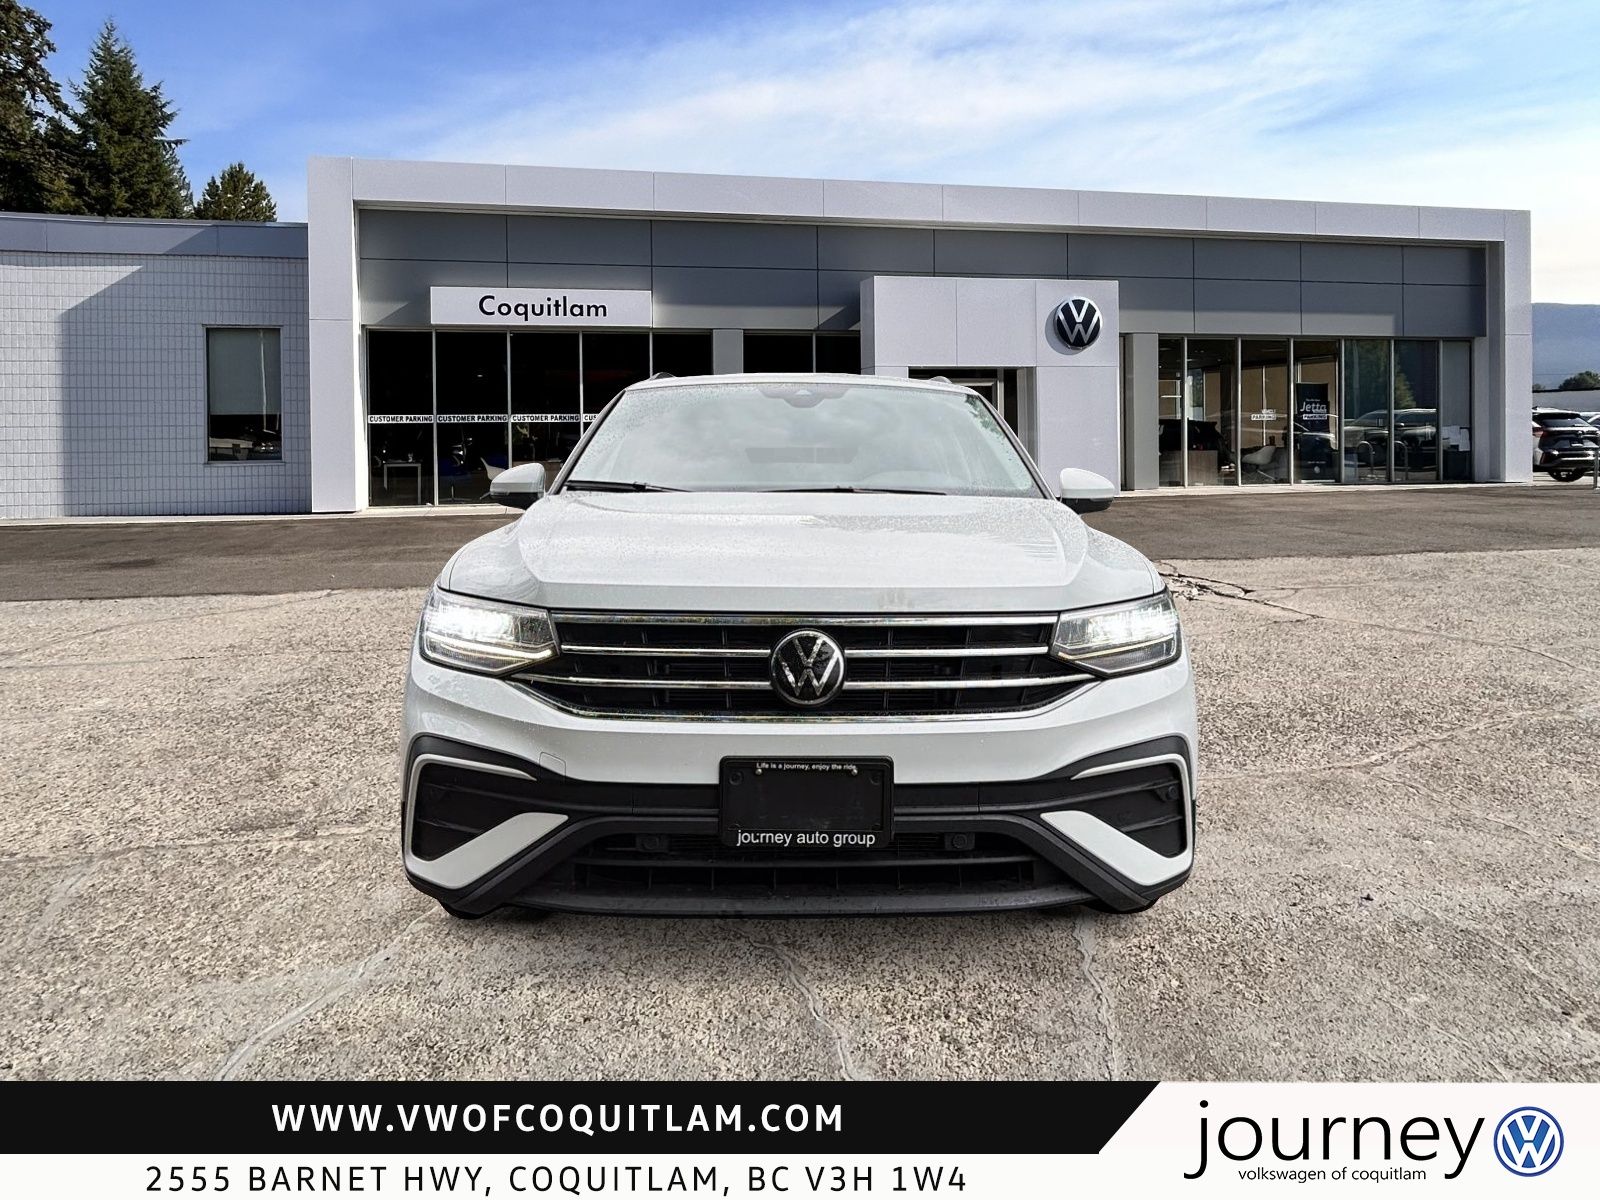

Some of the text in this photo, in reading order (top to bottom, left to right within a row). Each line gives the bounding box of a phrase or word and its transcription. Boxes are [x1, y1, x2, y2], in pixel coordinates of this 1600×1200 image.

[479, 295, 606, 321] Coquitlam
[1300, 401, 1327, 412] Jetta
[369, 415, 433, 423] CUSTOMER PARKING
[438, 414, 508, 422] CUSTOMER PARKING
[512, 414, 579, 422] CUSTOMER PARKING
[736, 829, 876, 847] journey auto group
